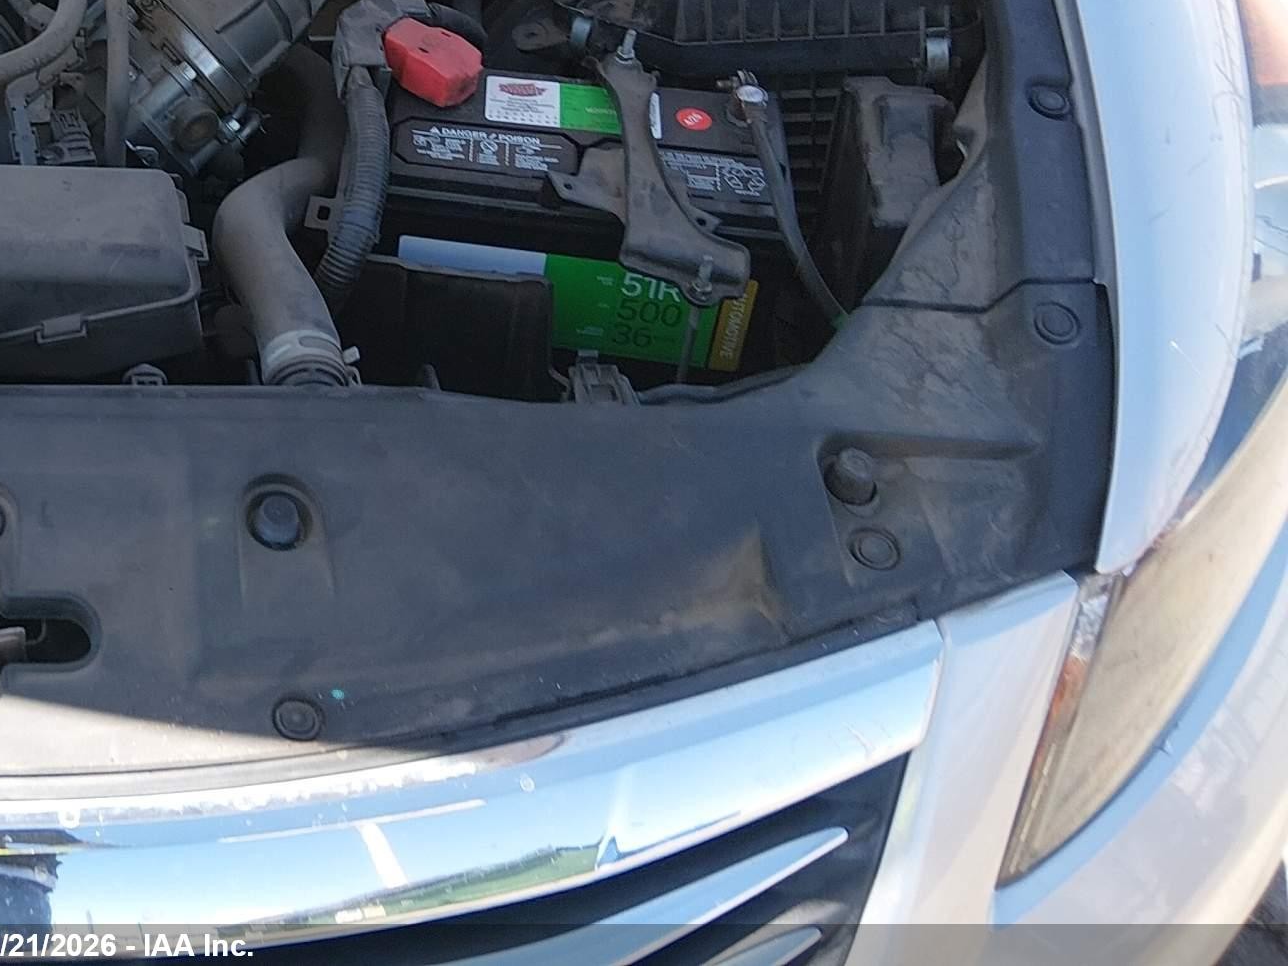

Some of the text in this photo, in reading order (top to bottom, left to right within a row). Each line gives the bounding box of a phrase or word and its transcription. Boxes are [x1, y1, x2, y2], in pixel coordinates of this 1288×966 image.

[441, 127, 487, 140] DANGER
[498, 133, 541, 145] POISON
[617, 299, 682, 327] 500
